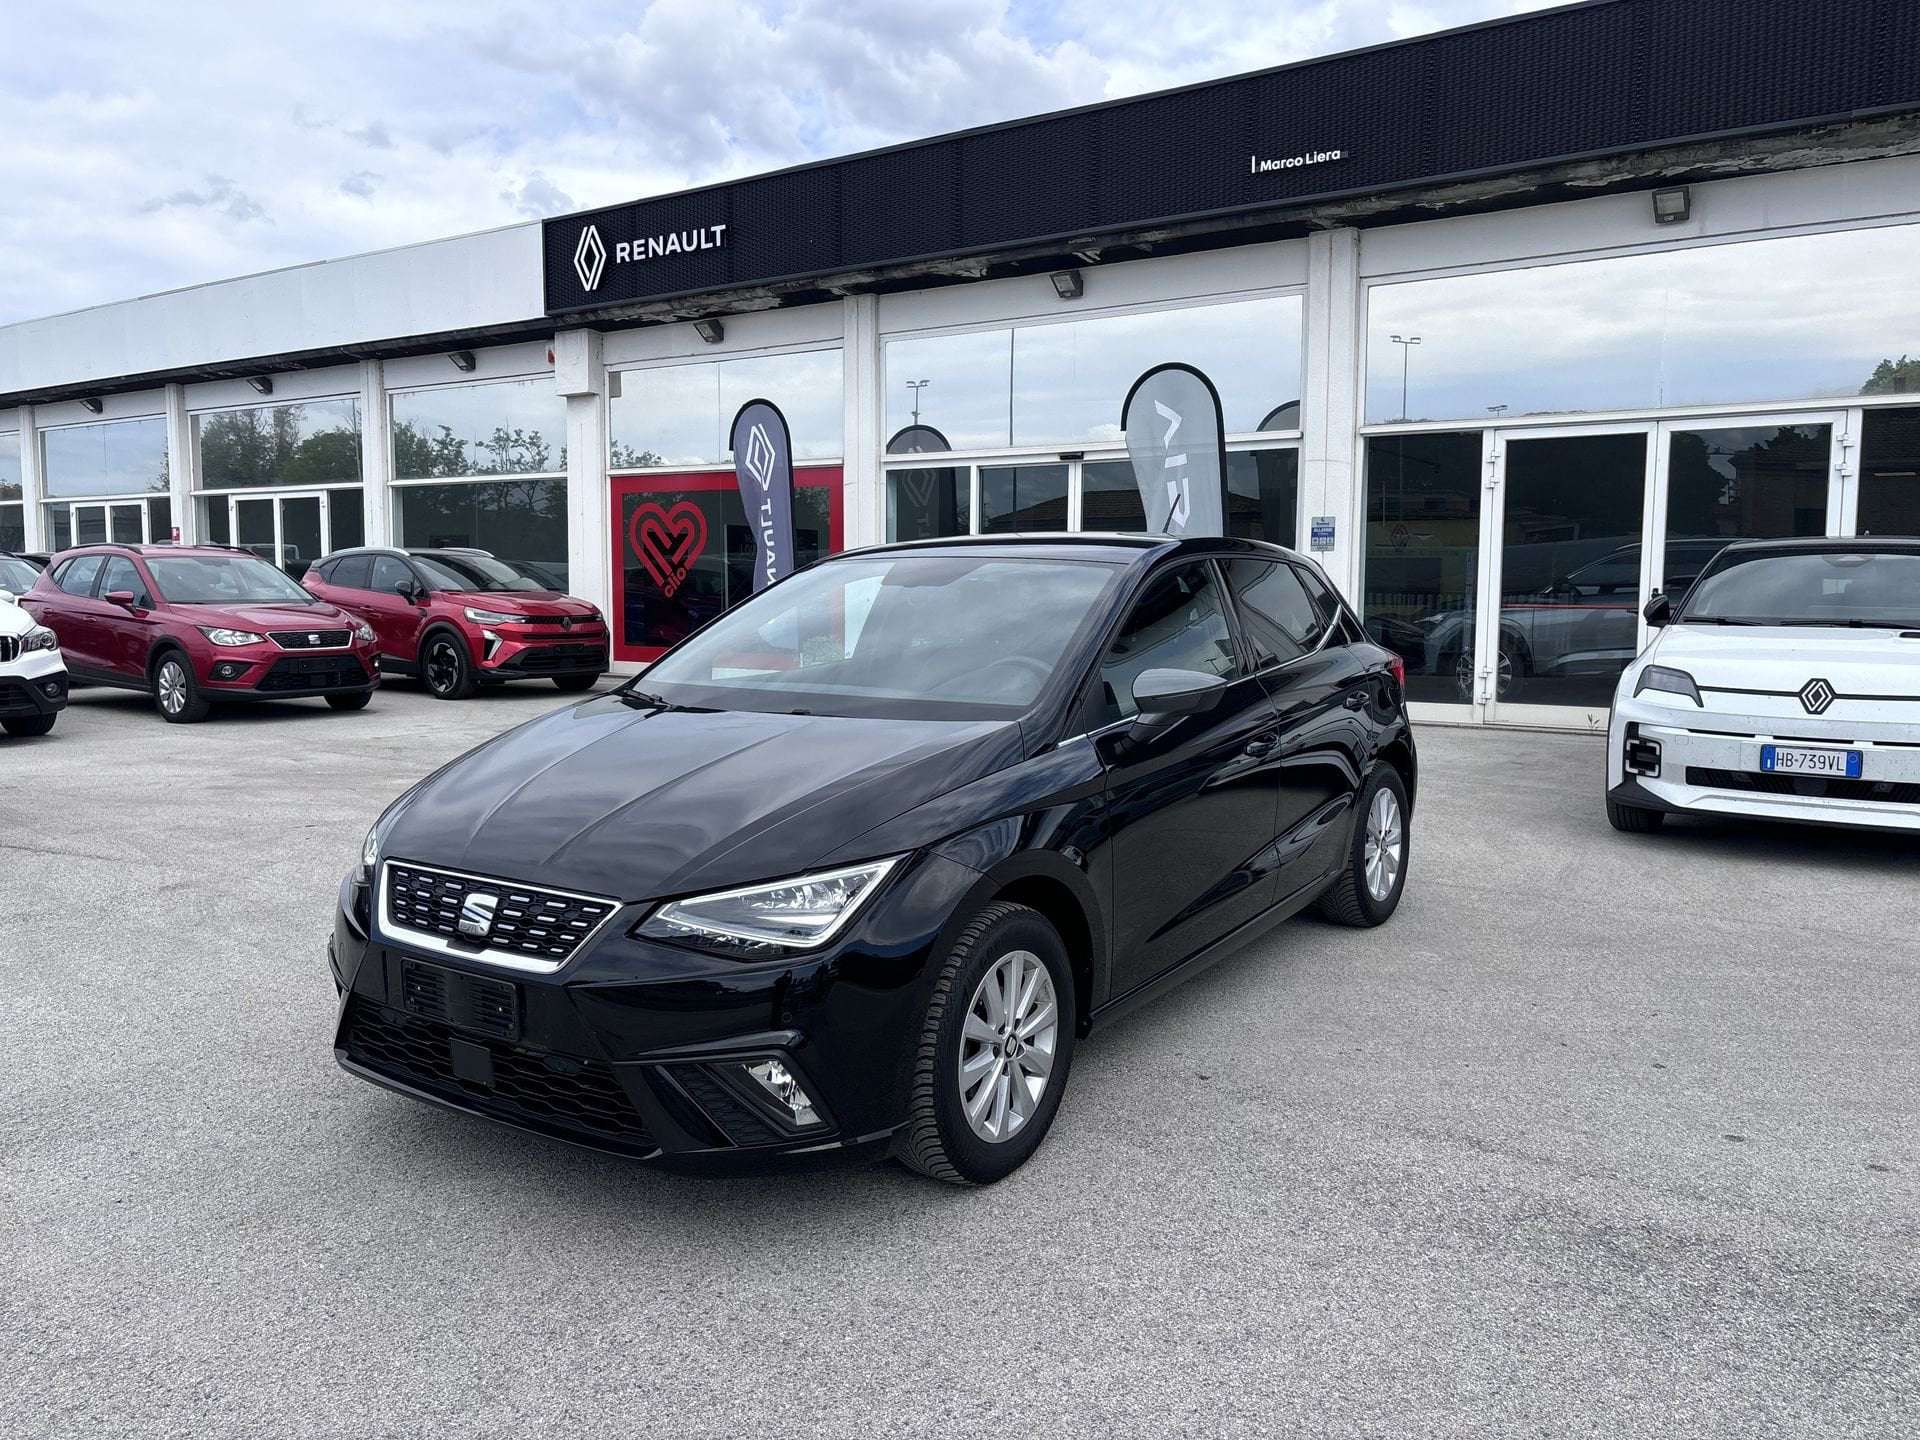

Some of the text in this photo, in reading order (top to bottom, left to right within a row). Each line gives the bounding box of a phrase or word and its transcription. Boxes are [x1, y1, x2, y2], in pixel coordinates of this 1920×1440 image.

[1260, 150, 1341, 172] Marco Liera
[615, 224, 727, 264] RENAULT
[664, 567, 687, 598] clio
